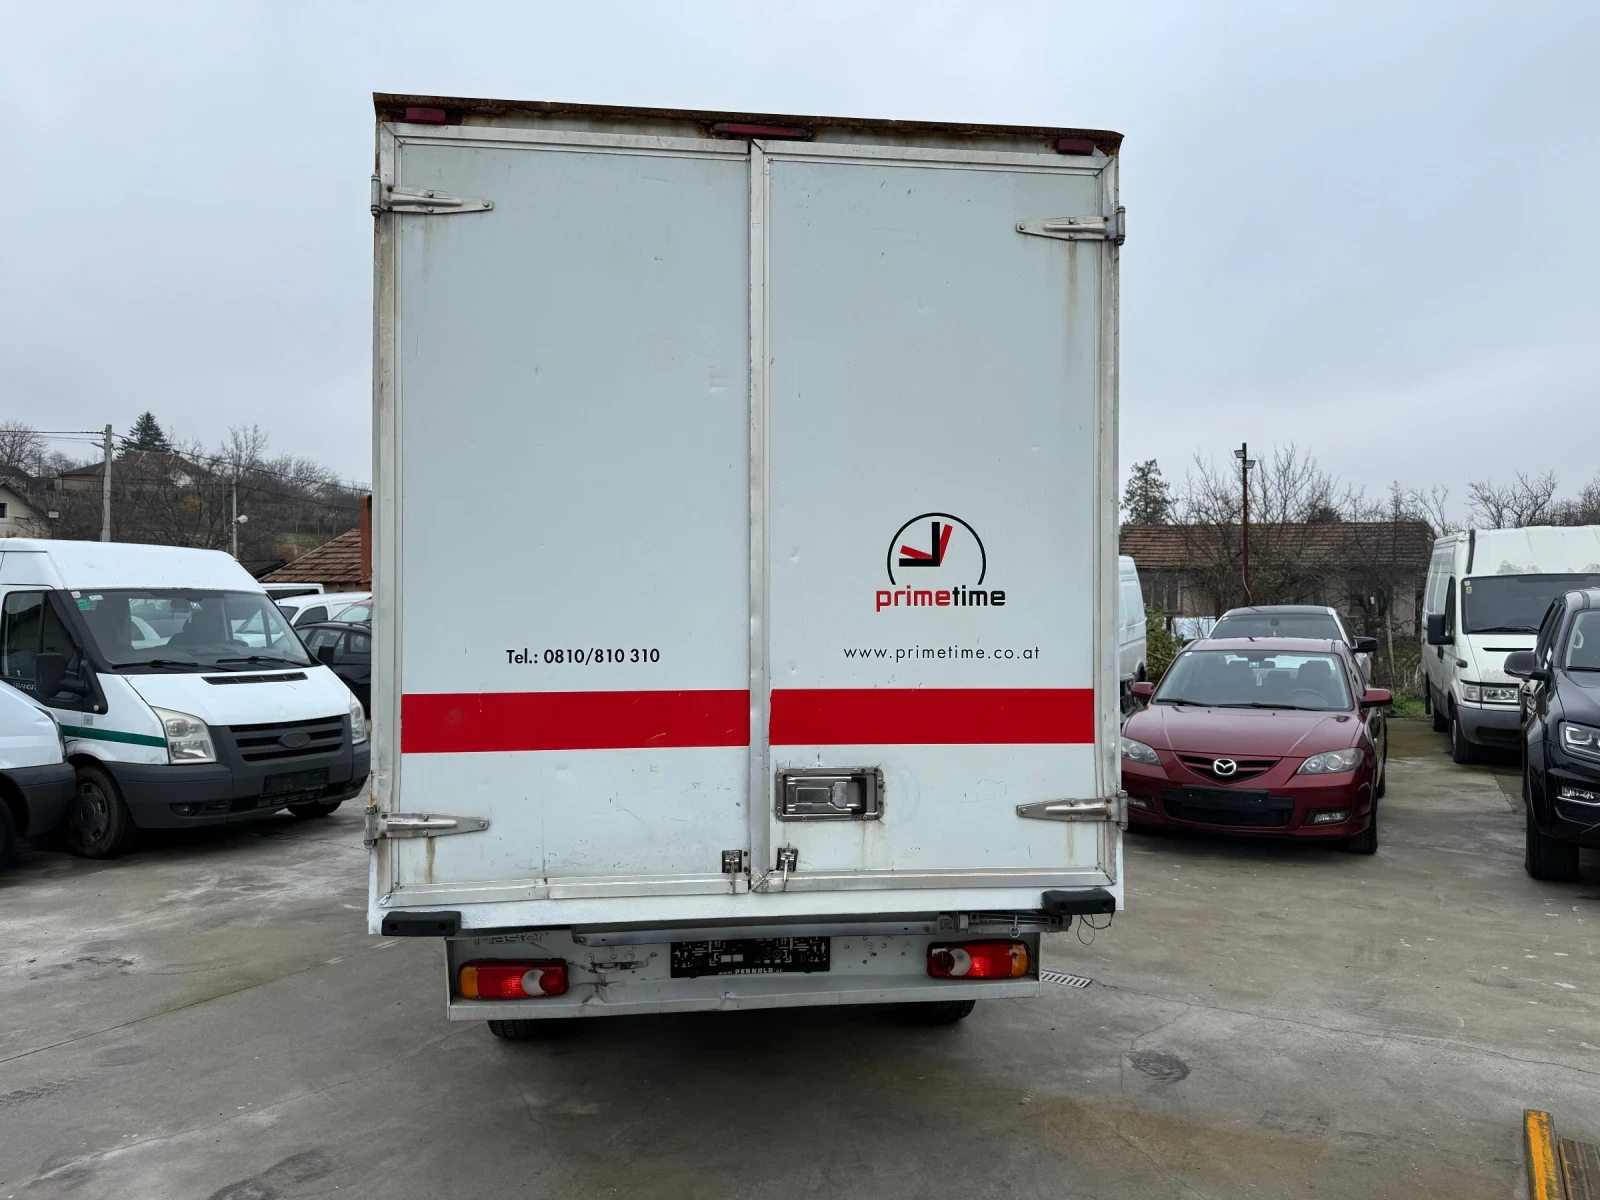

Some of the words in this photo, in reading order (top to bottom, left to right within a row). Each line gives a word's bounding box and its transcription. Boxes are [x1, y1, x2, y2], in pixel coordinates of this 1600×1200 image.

[876, 585, 1006, 612] primetime
[506, 648, 538, 664] Tel.:
[543, 648, 625, 665] 0810/810
[630, 648, 660, 663] 310
[844, 645, 1040, 663] www.primetime.co.at
